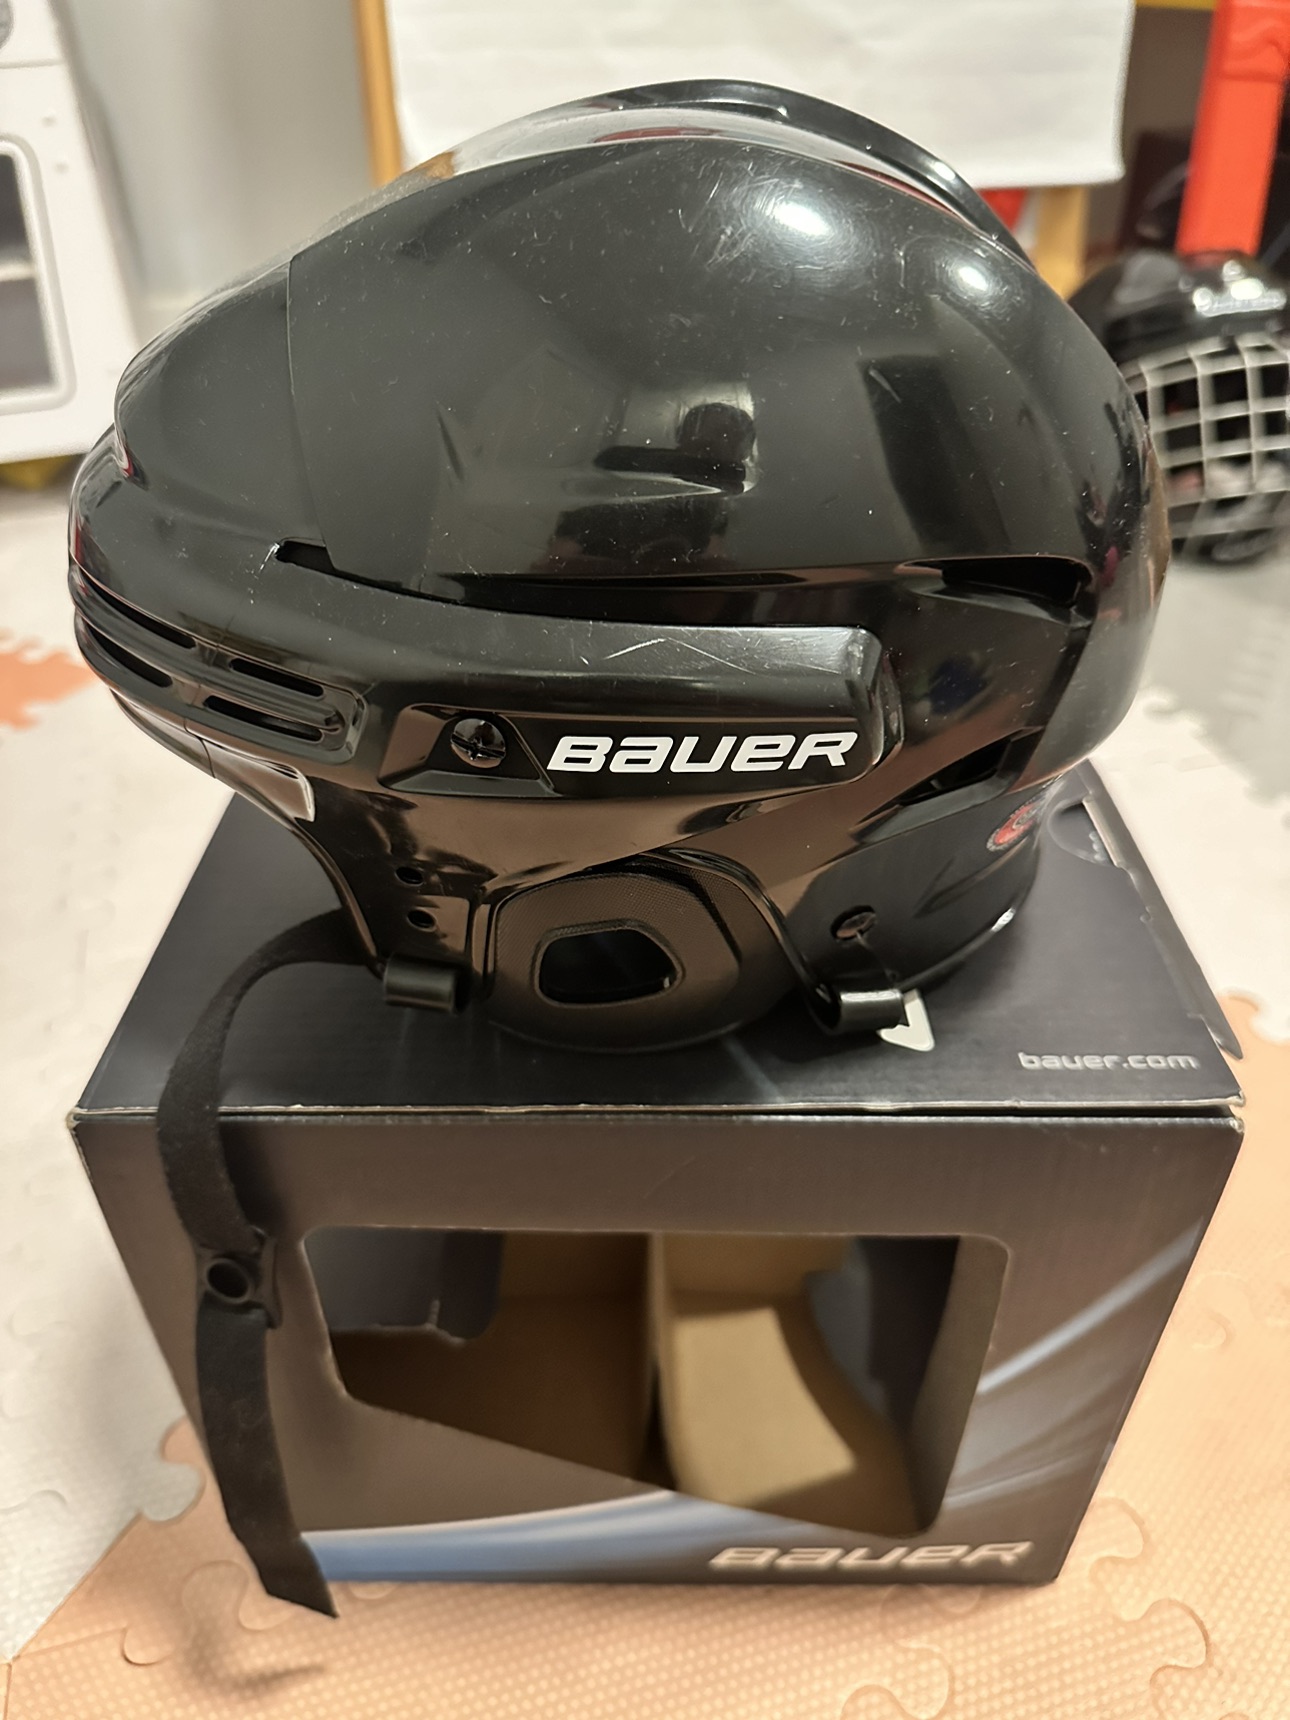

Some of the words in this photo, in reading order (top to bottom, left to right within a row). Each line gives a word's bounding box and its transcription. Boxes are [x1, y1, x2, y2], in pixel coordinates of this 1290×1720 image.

[546, 732, 858, 773] BAUER
[1018, 1052, 1200, 1071] bauer.com
[708, 1541, 1034, 1571] BAUER
